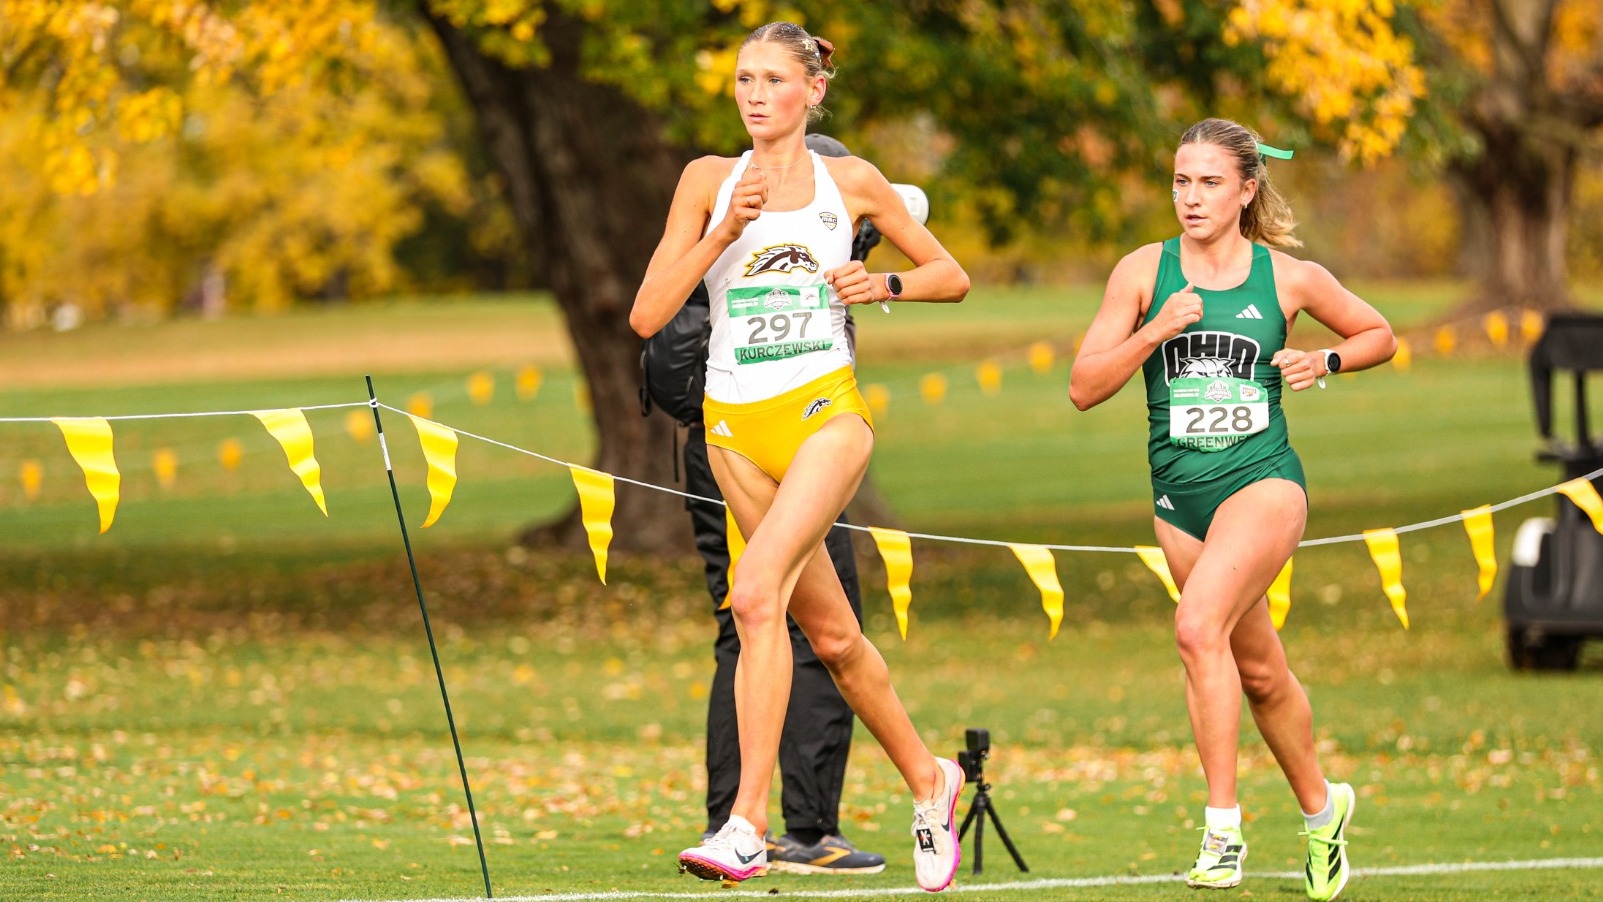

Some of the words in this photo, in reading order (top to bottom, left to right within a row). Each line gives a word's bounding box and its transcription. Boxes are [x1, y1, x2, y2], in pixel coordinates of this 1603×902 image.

[747, 312, 812, 345] 297
[739, 340, 826, 362] KURCZEWSKI
[1163, 332, 1259, 384] OHIO
[1186, 407, 1253, 433] 228
[1177, 435, 1248, 449] GREENWE
